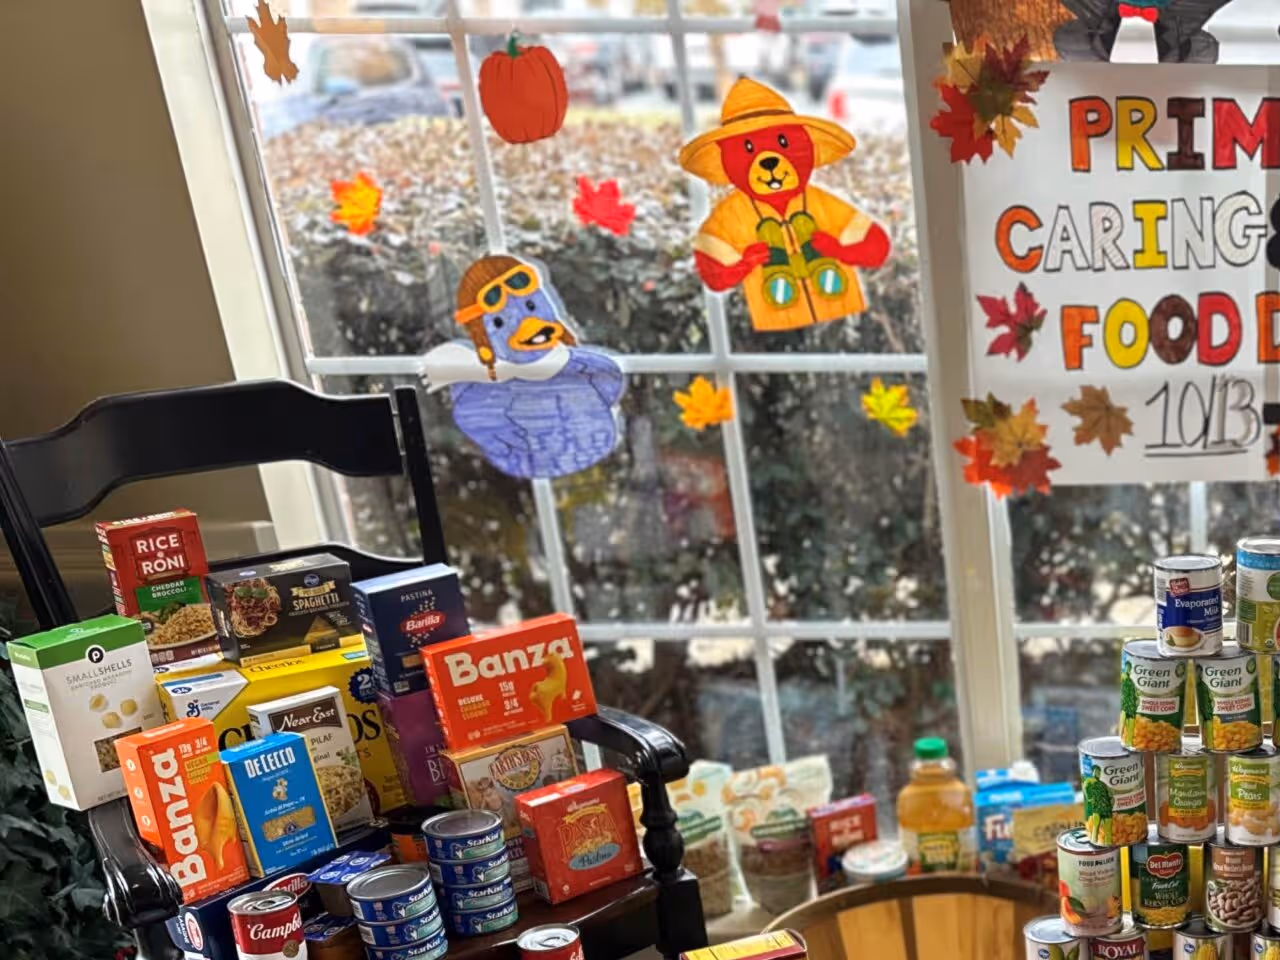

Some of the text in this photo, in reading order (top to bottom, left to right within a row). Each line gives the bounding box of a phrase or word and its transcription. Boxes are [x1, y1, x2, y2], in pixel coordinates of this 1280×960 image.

[1060, 291, 1243, 371] FOOD
[137, 534, 180, 553] RICE
[142, 556, 185, 575] RONI
[293, 595, 340, 611] SPAGHETTI
[401, 589, 432, 602] PASTINA
[1175, 597, 1219, 609] Evaporated
[405, 615, 440, 631] Barilla
[444, 636, 574, 687] Banza
[1134, 663, 1170, 677] Green
[1205, 665, 1241, 677] Green
[1137, 677, 1170, 689] Giant
[1210, 677, 1242, 688] Giant
[313, 706, 336, 723] East
[1104, 762, 1138, 776] Green
[1109, 773, 1140, 786] Giant
[152, 748, 207, 888] Banza
[1099, 945, 1139, 960] ROYAL
